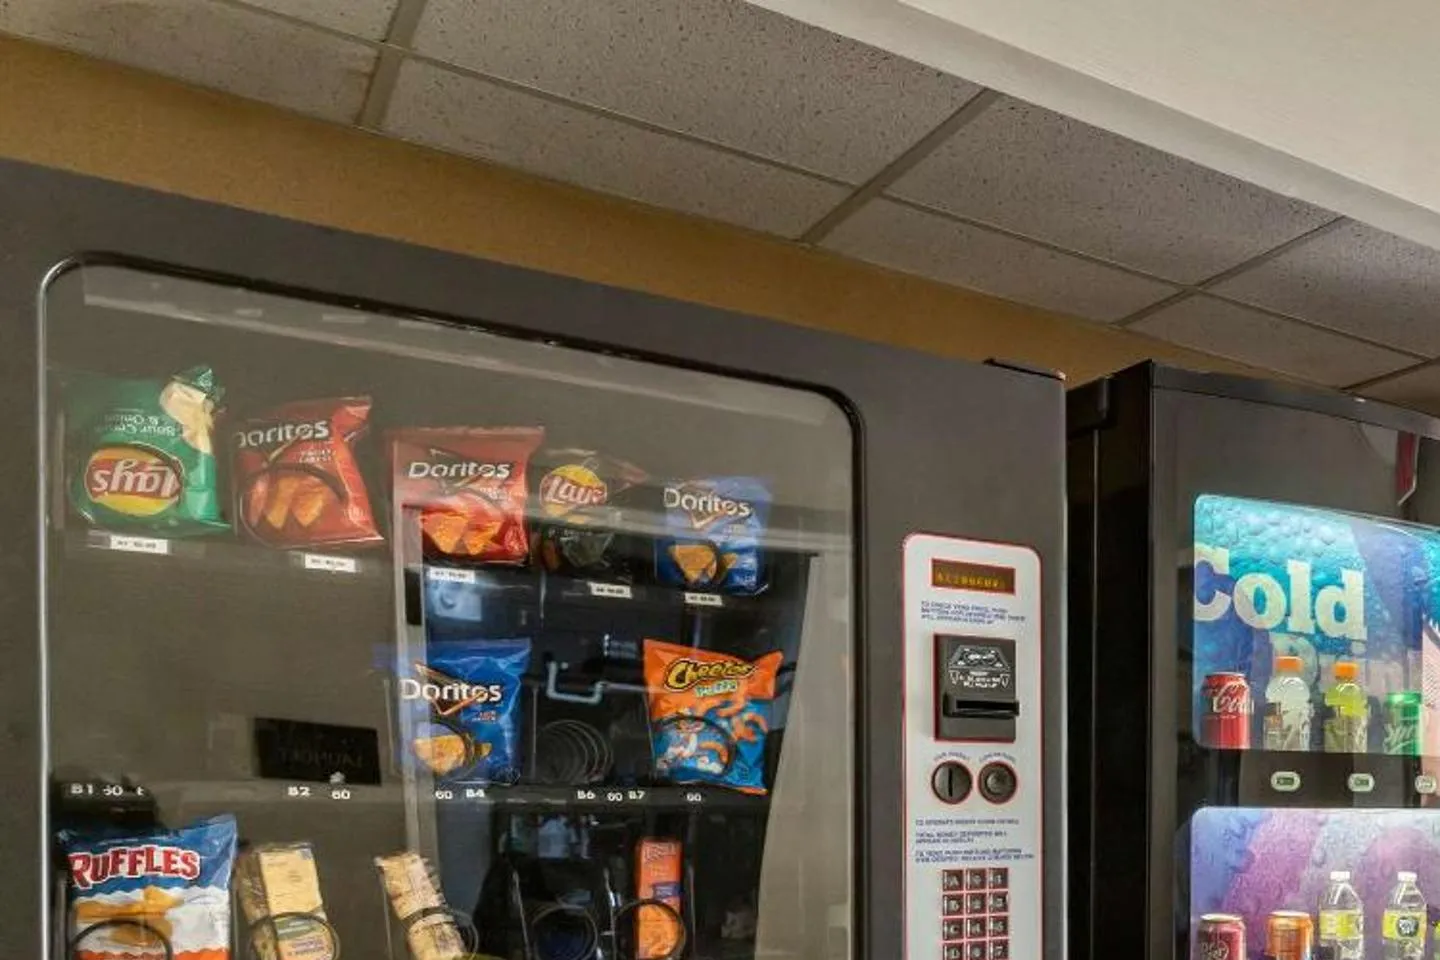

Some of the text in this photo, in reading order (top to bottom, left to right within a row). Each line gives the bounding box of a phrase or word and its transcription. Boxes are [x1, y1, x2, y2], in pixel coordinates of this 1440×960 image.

[408, 461, 511, 478] Doritos
[663, 487, 751, 518] Doritos
[1194, 543, 1368, 641] Cold
[400, 678, 502, 703] Doritos
[68, 844, 201, 889] RUFFLES
